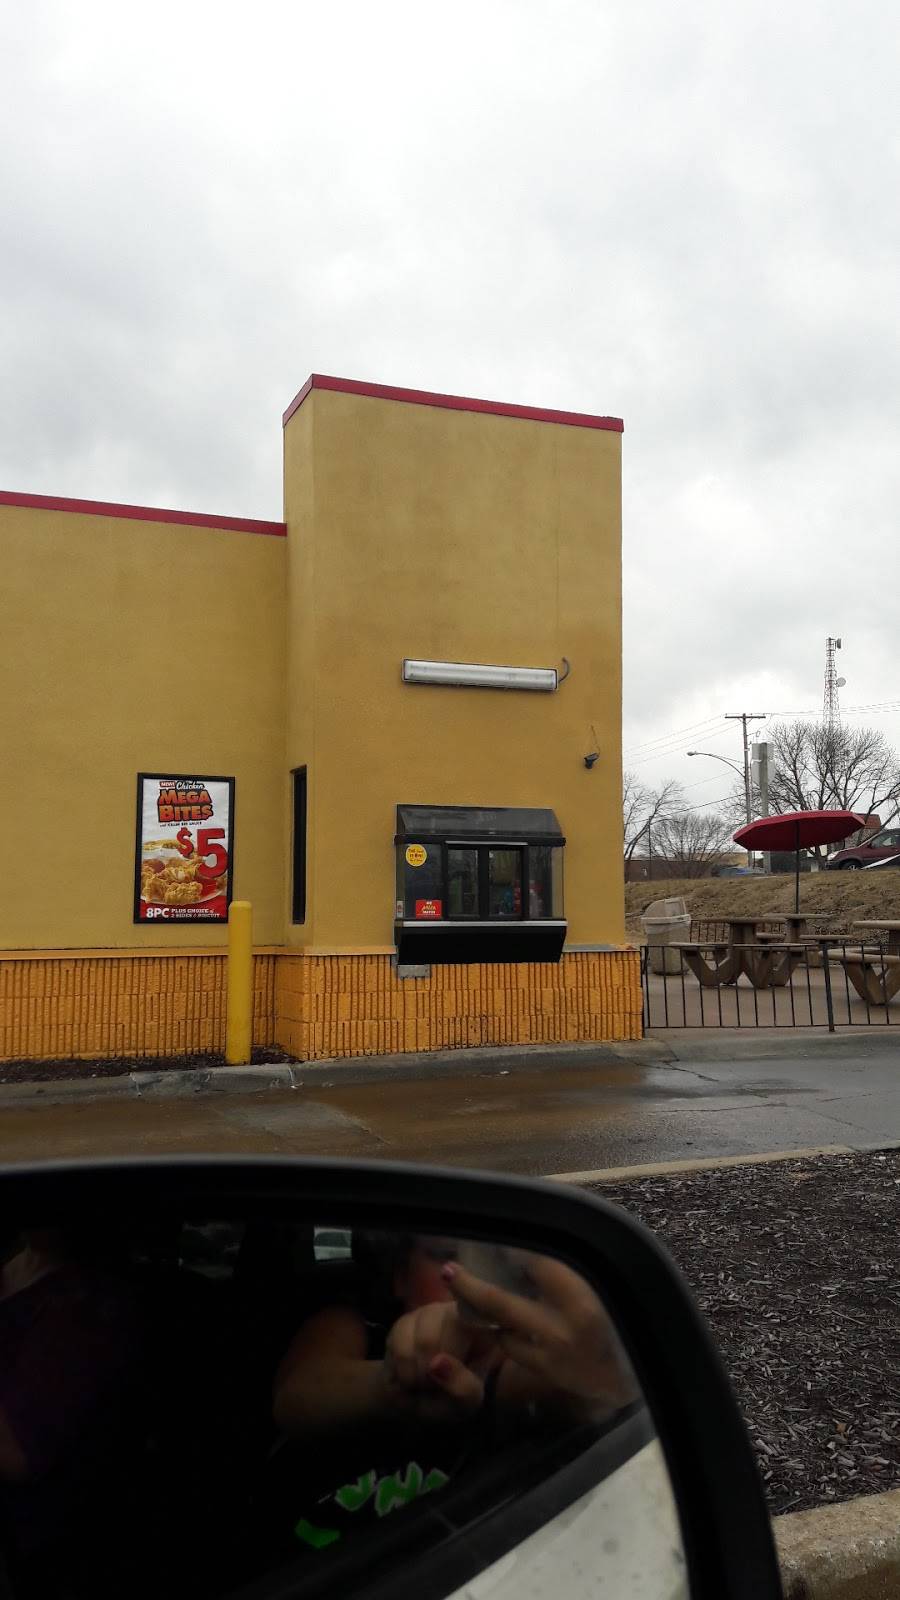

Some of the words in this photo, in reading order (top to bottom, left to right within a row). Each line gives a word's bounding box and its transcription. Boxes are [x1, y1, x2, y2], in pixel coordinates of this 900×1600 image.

[176, 780, 205, 791] Chicken
[158, 789, 212, 805] MEGA
[158, 805, 214, 822] BITES
[176, 827, 228, 878] $5
[146, 908, 170, 918] 8PC
